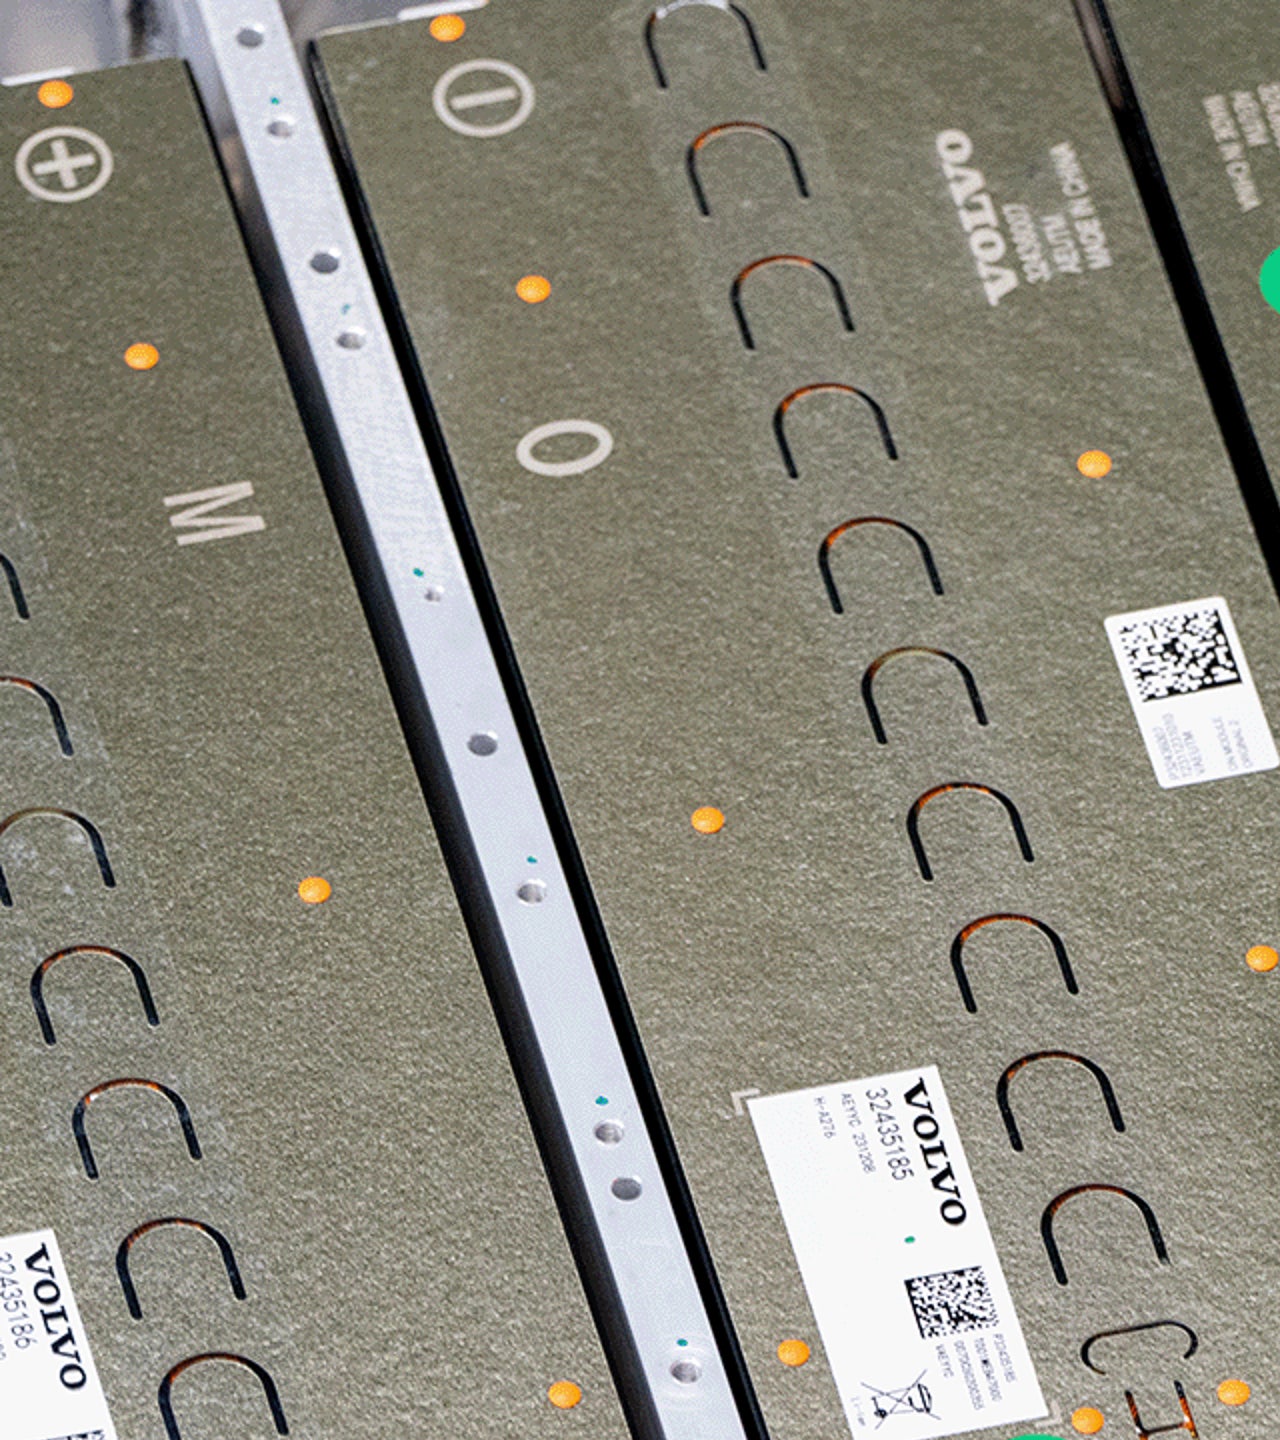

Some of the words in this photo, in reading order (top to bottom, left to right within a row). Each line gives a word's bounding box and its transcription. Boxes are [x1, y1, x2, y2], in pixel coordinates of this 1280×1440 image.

[935, 128, 1020, 307] VOLVO
[163, 482, 266, 547] M
[866, 1088, 914, 1180] 32435185
[904, 1077, 966, 1226] VOLVO
[25, 1242, 86, 1390] VOLVO
